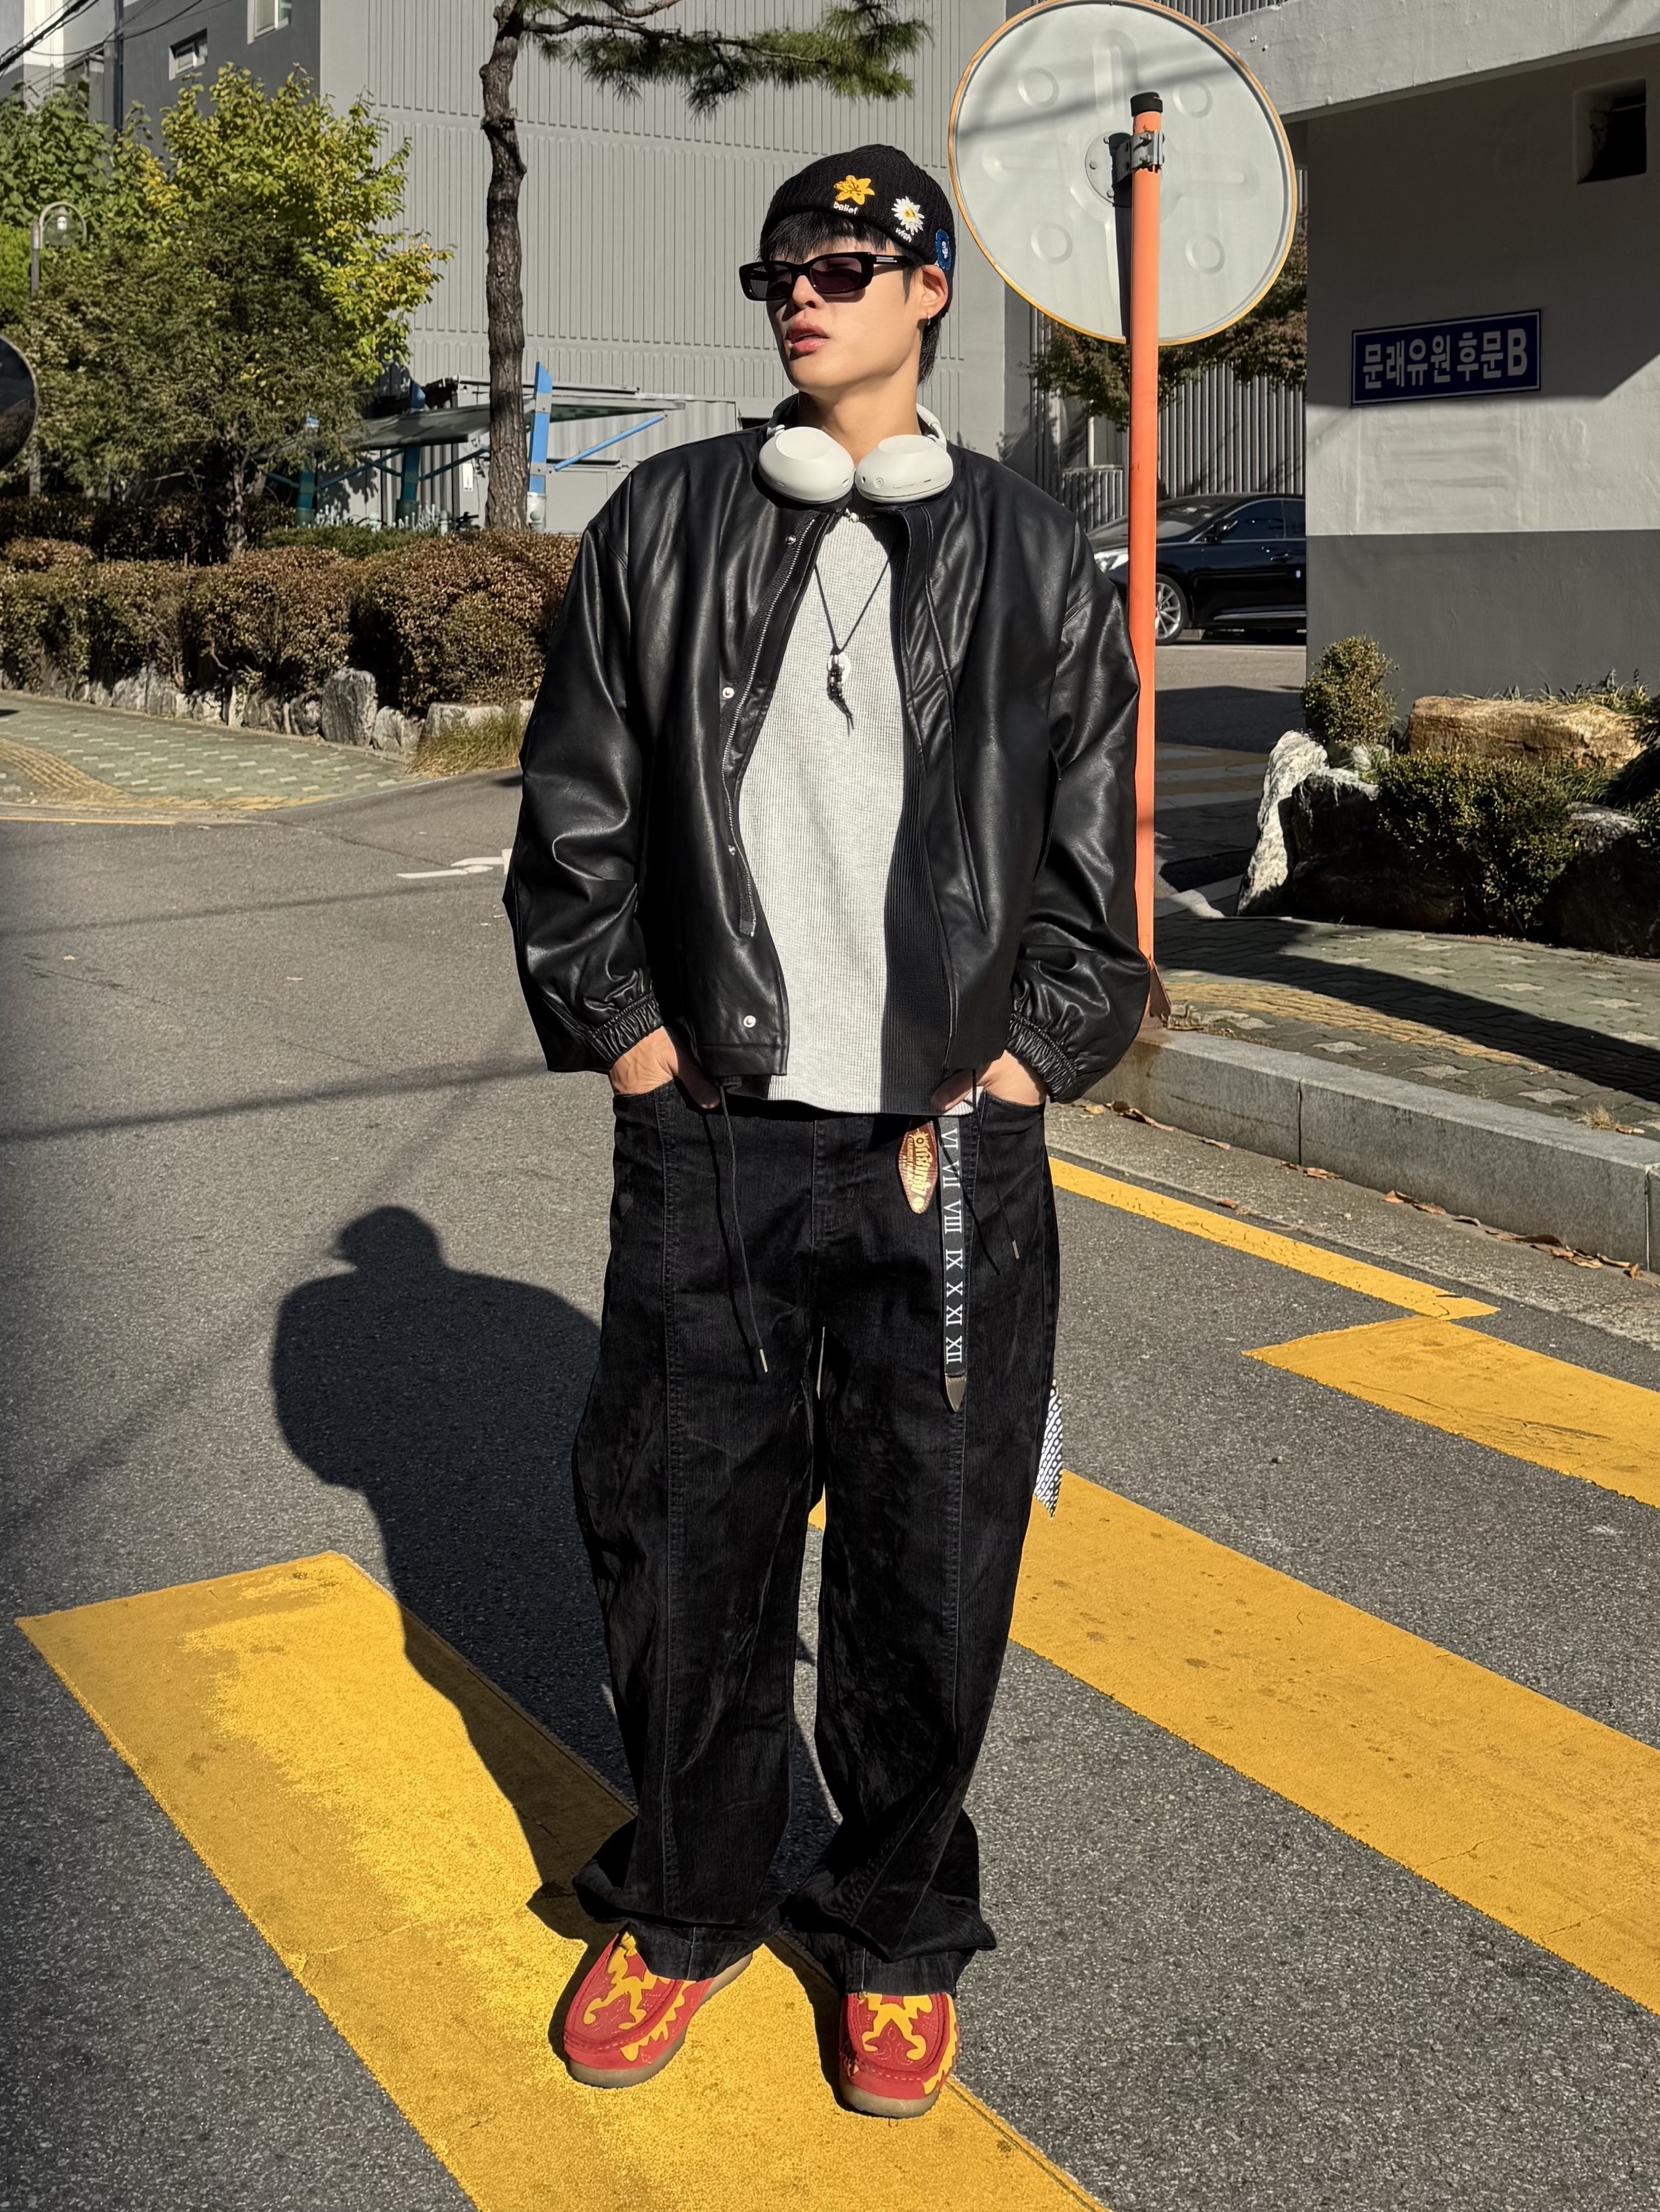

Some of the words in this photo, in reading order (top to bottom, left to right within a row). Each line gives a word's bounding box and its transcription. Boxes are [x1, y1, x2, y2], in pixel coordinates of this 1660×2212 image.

[941, 1127, 959, 1150] VI
[942, 1160, 961, 1189] VII
[943, 1199, 962, 1235] VIII
[945, 1248, 963, 1271] IX
[946, 1281, 963, 1298] X
[946, 1304, 963, 1327] XI
[946, 1335, 962, 1365] XII
